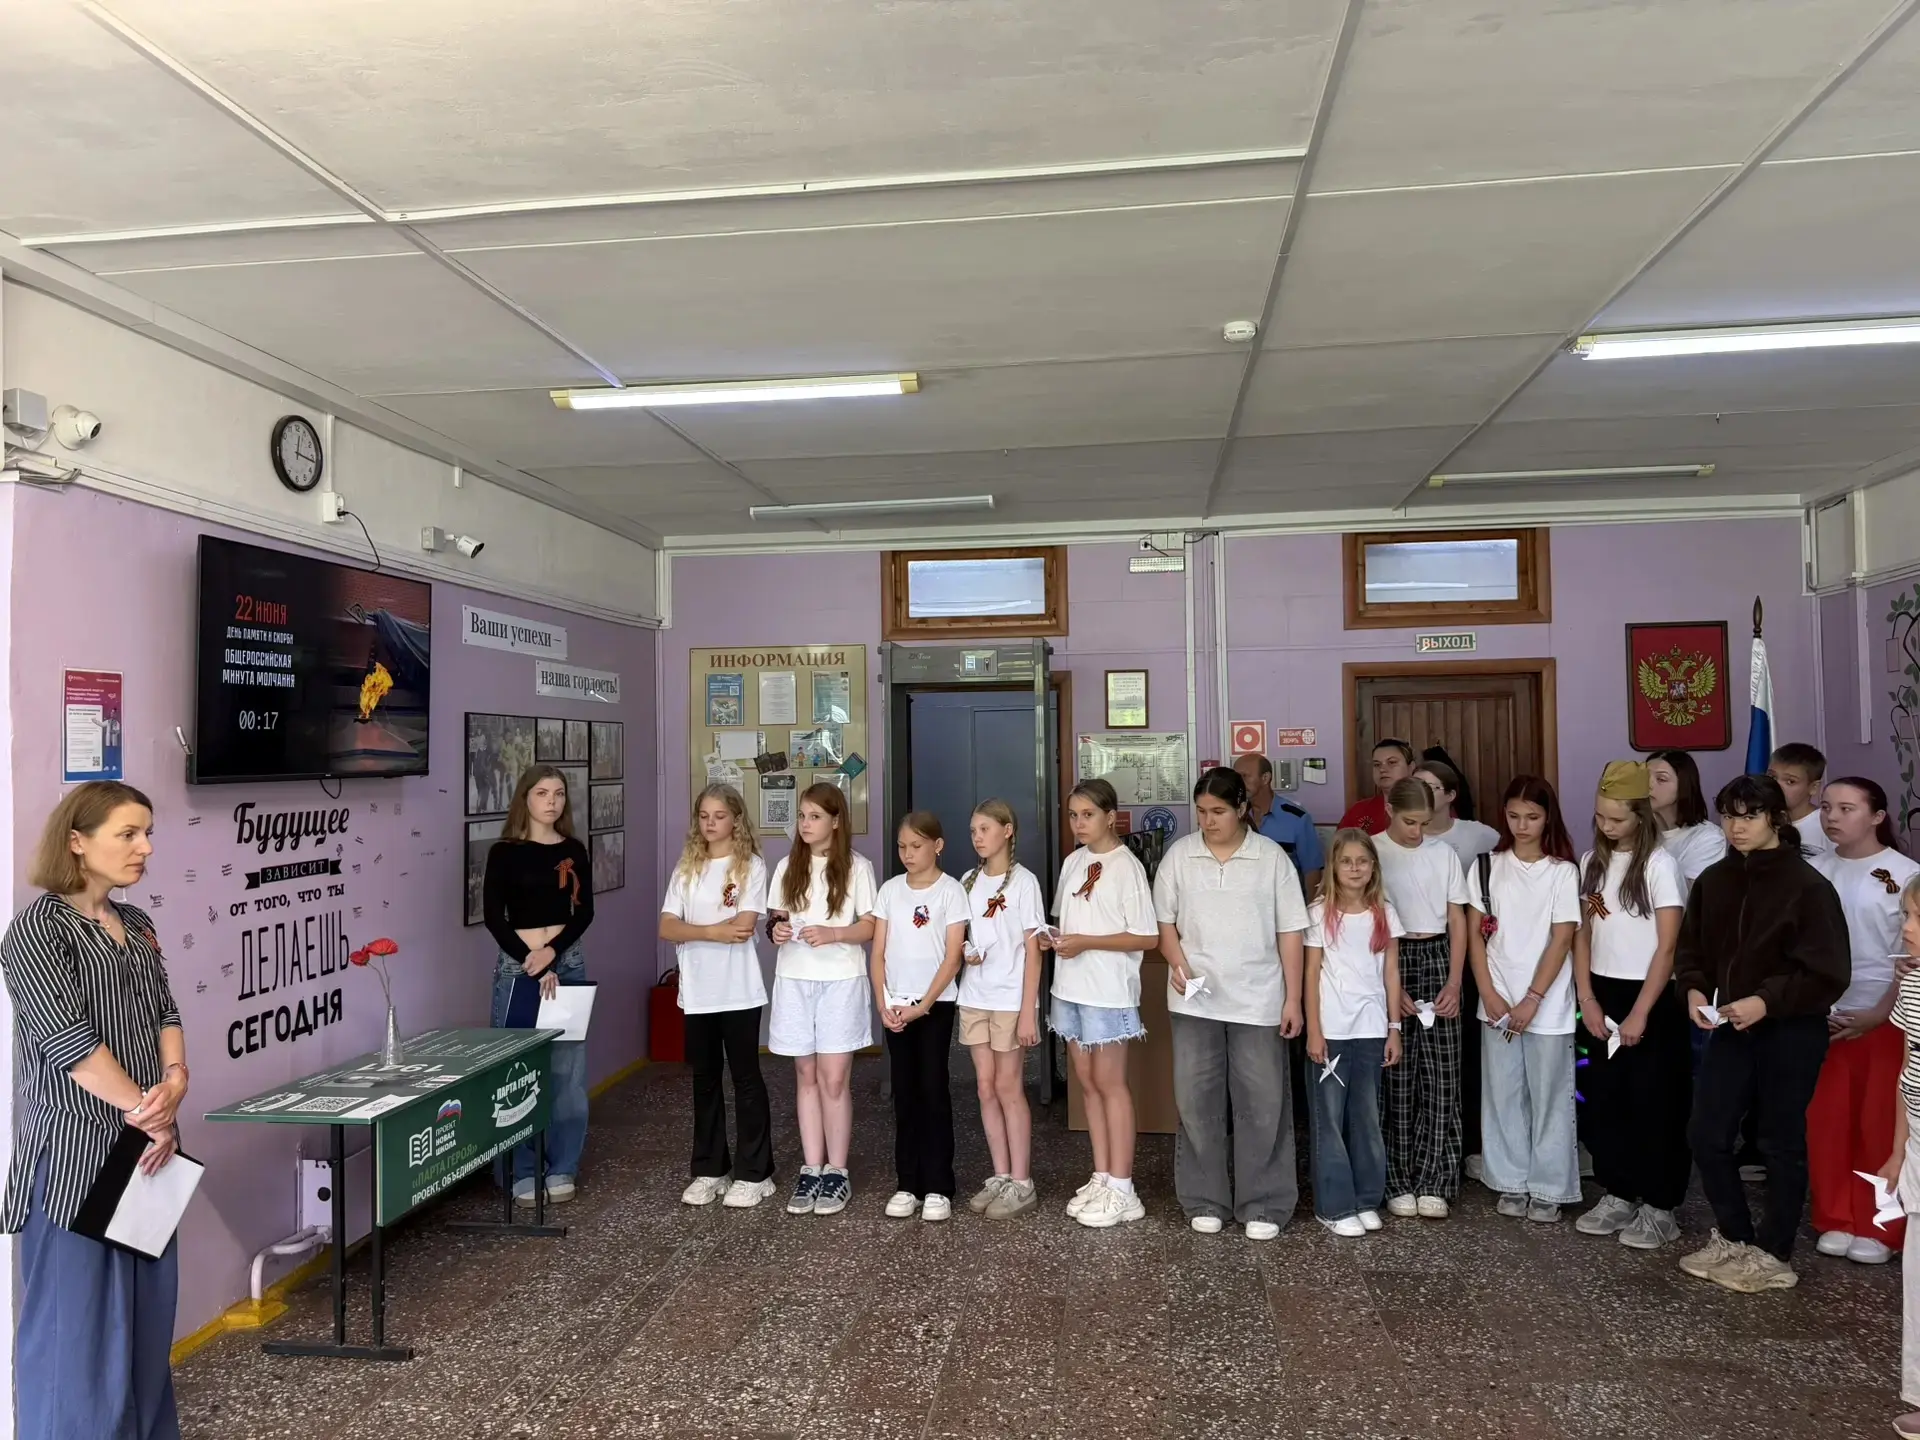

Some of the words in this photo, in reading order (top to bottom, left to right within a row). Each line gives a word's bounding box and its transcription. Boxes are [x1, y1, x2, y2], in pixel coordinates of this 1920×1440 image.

[235, 595, 253, 621] 22
[255, 601, 288, 625] ИЮНЯ
[226, 626, 242, 639] ДЕНЬ
[243, 628, 267, 642] ПАМЯТИ
[268, 631, 272, 643] И
[273, 632, 294, 645] СКОРБИ
[470, 611, 508, 639] Ваши
[511, 624, 551, 647] успехи
[1422, 636, 1471, 648] ВЫХОД
[225, 648, 292, 669] ОБЩЕРОССИЙСКАЯ
[709, 651, 846, 668] ИНФОРМАЦИЯ
[222, 669, 255, 686] МИНУТА
[256, 672, 295, 688] МОЛЧАНИЯ
[541, 670, 571, 688] наша
[573, 675, 618, 696] гордость!
[238, 710, 279, 730] 00:17
[233, 802, 350, 854] Будущее
[265, 860, 325, 882] ЗАВИСИТ
[237, 909, 350, 1001] ДЕЛАЕШЬ
[227, 987, 343, 1060] СЕГОДНЯ
[496, 1080, 518, 1101] ПАРТА
[517, 1069, 537, 1089] ГЕРОЯ
[435, 1119, 457, 1137] ПРОЕКТ
[435, 1130, 455, 1146] НОВАЯ
[435, 1139, 457, 1156] ШКОЛА
[411, 1181, 441, 1206] ПРОЕКТ,
[441, 1144, 498, 1187] ОБЪЕДИНЯЮЩИЙ
[498, 1123, 534, 1152] ПОКОЛЕНИЯ
[412, 1163, 446, 1189] «ПАРТА
[447, 1143, 478, 1169] ГЕРОЯ»
